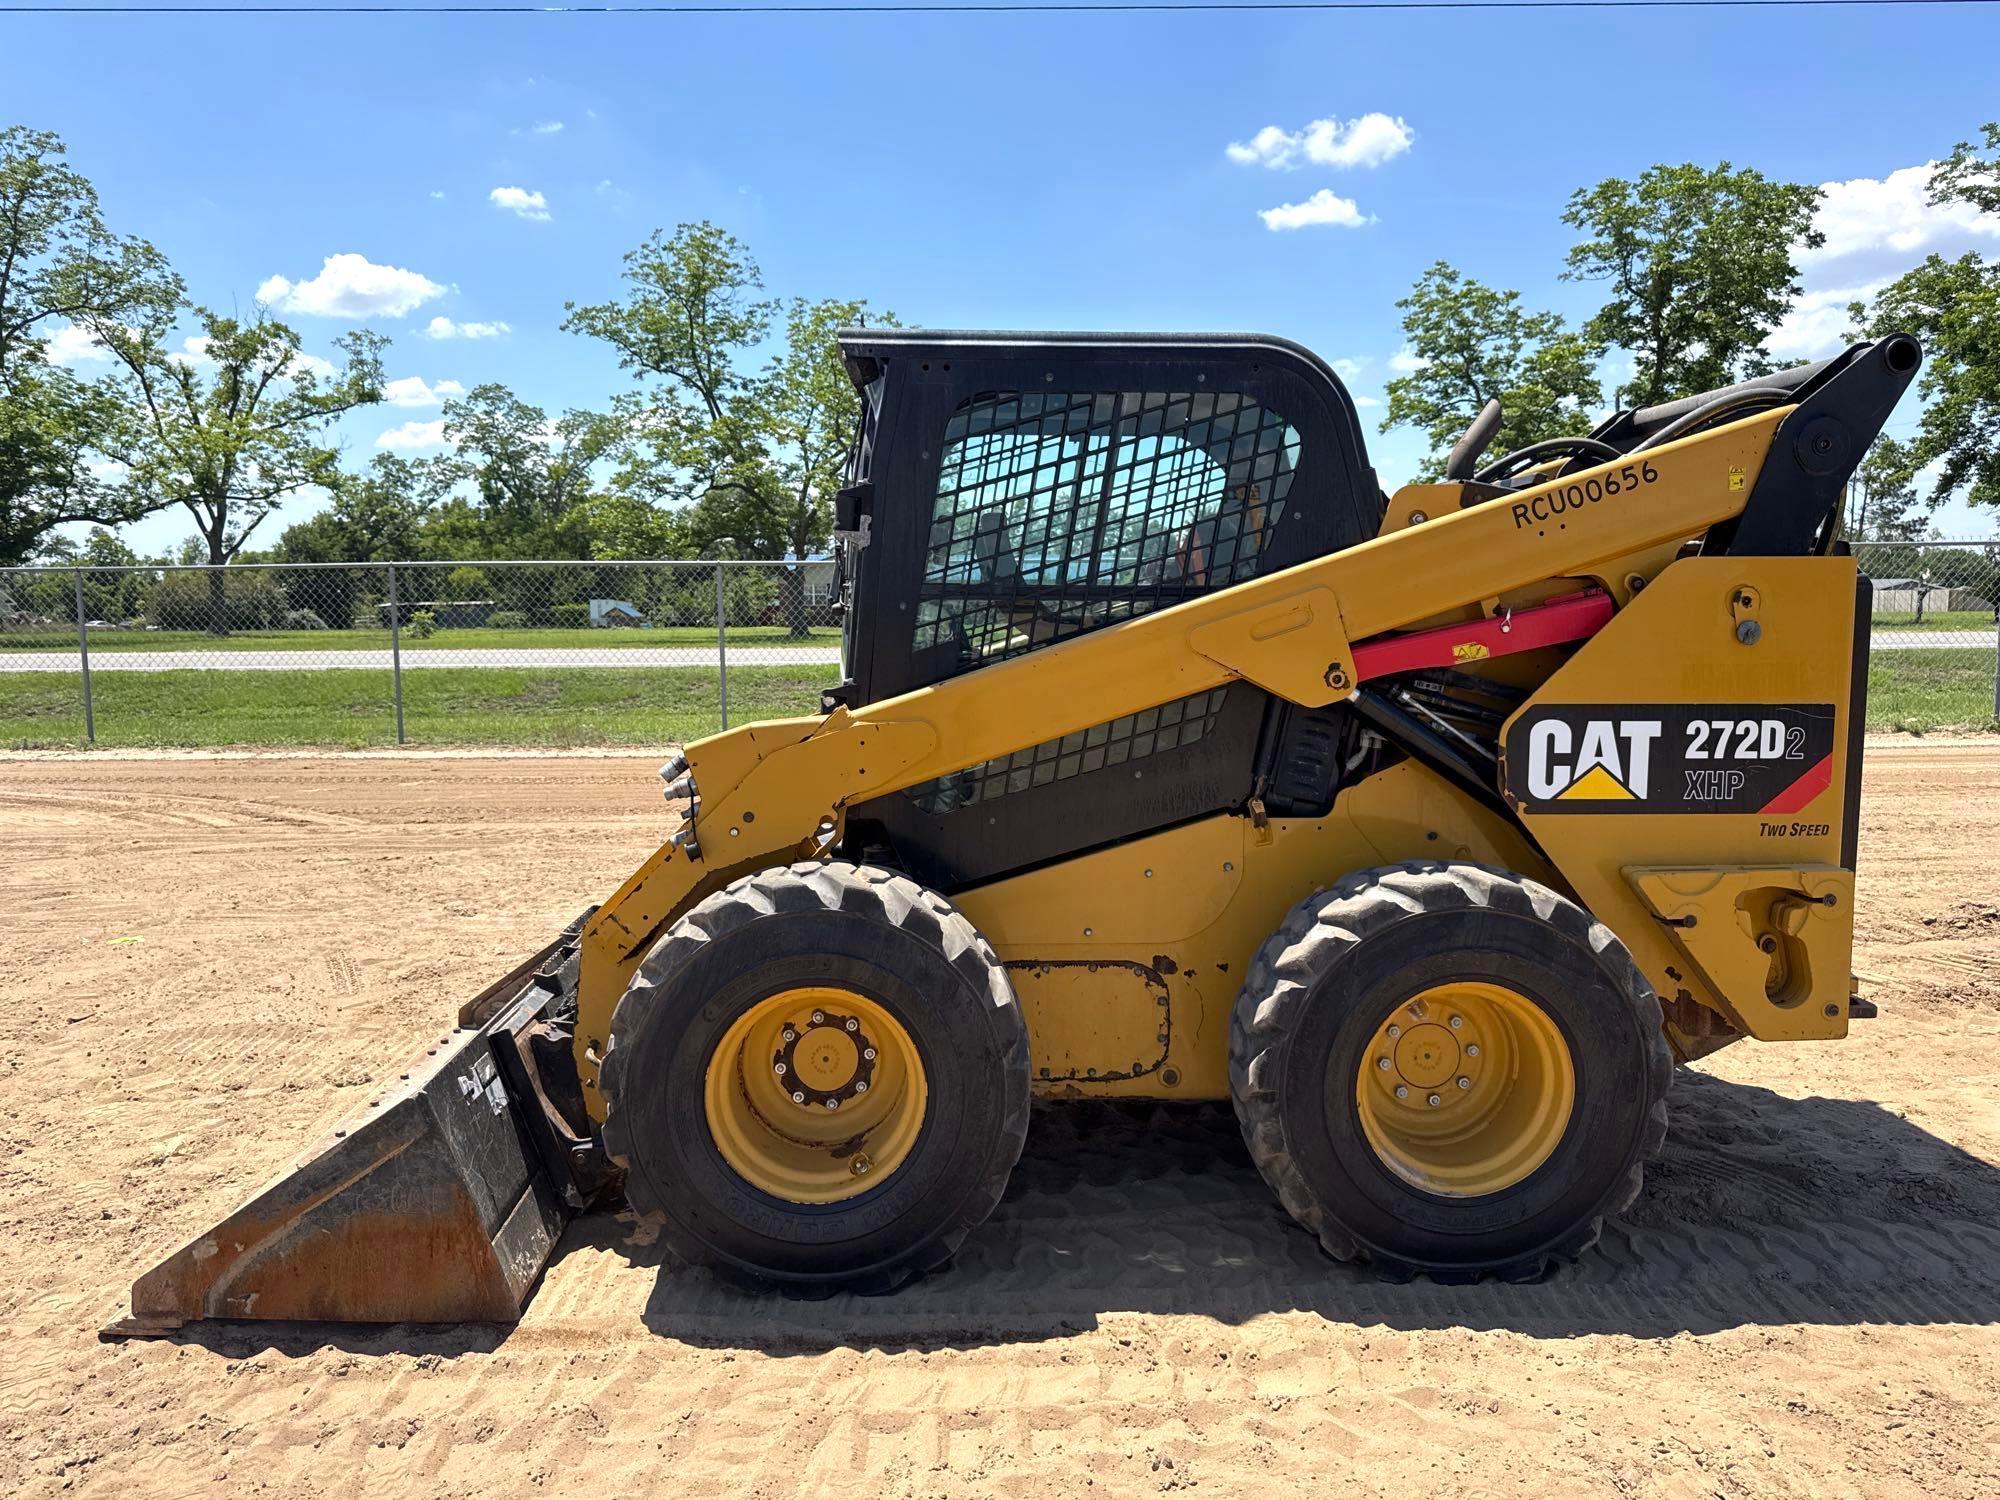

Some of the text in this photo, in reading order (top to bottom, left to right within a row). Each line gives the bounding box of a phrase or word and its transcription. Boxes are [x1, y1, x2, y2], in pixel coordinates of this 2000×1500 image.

[1512, 461, 1658, 528] RCU00656
[1528, 719, 1662, 799] CAT
[1684, 770, 1745, 799] XHP
